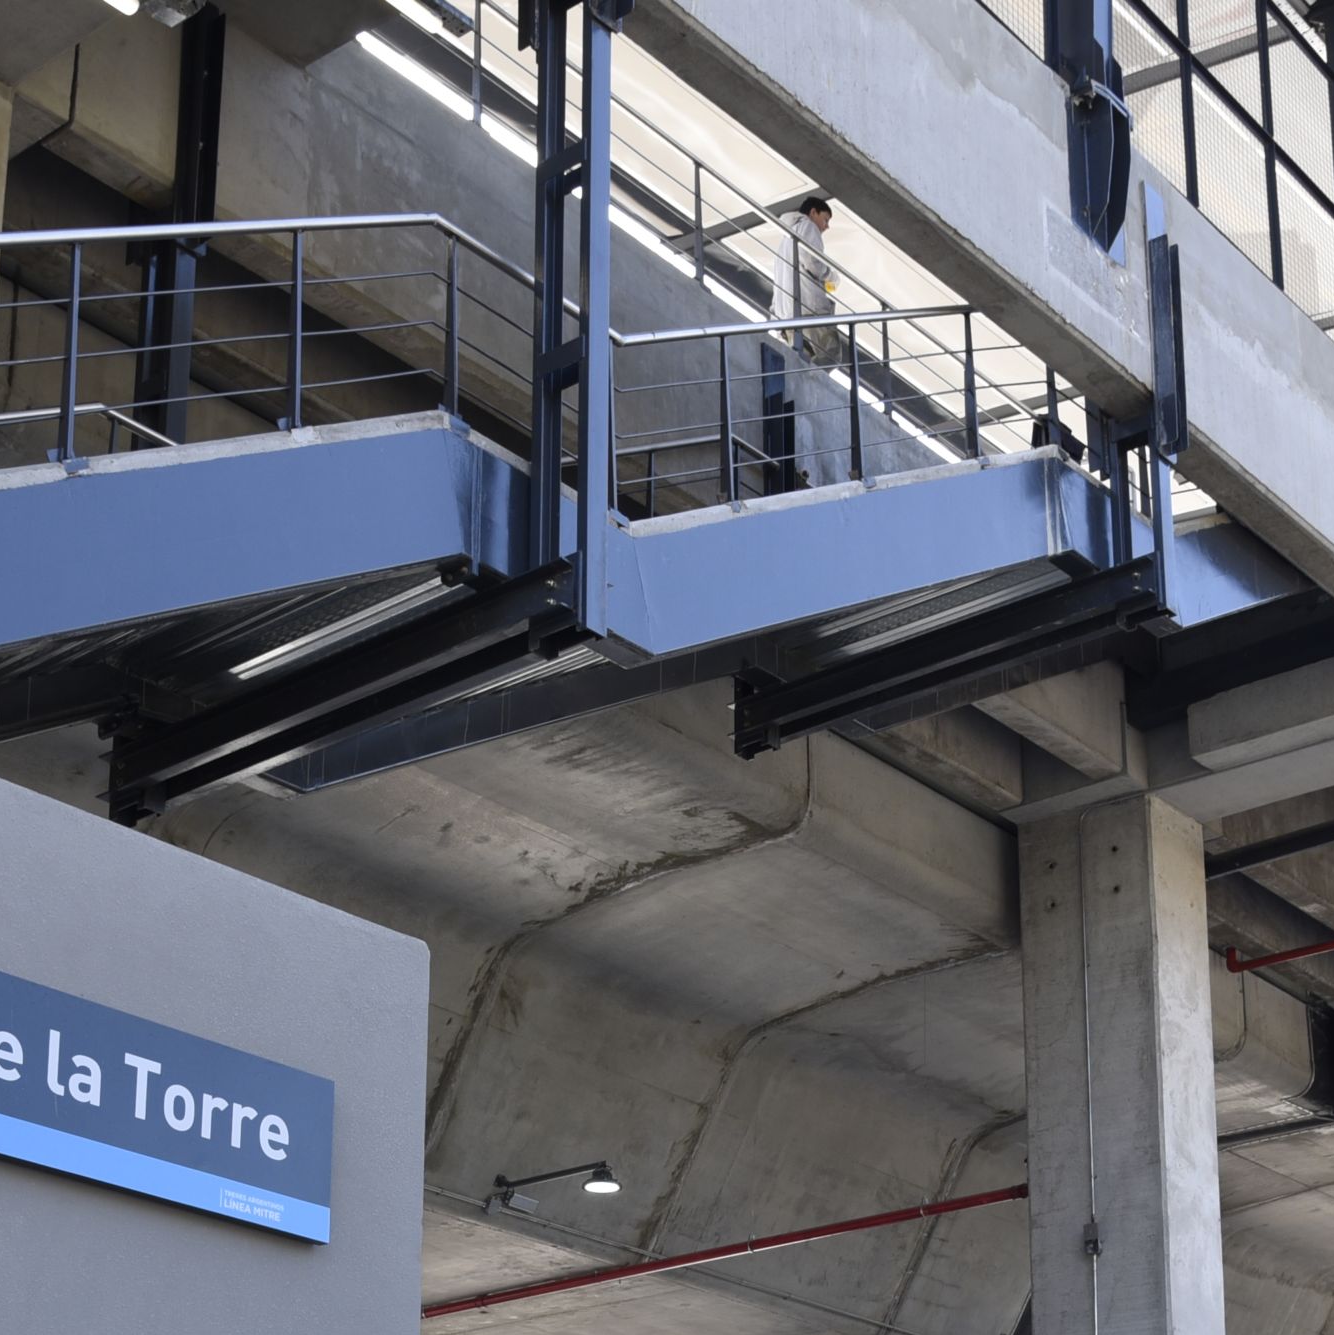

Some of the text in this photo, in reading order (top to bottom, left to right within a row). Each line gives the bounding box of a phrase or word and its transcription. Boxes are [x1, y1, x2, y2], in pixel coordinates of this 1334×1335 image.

[47, 1029, 102, 1107] la
[124, 1052, 289, 1161] Torre
[223, 1197, 281, 1222] LÍNEA MITRE
